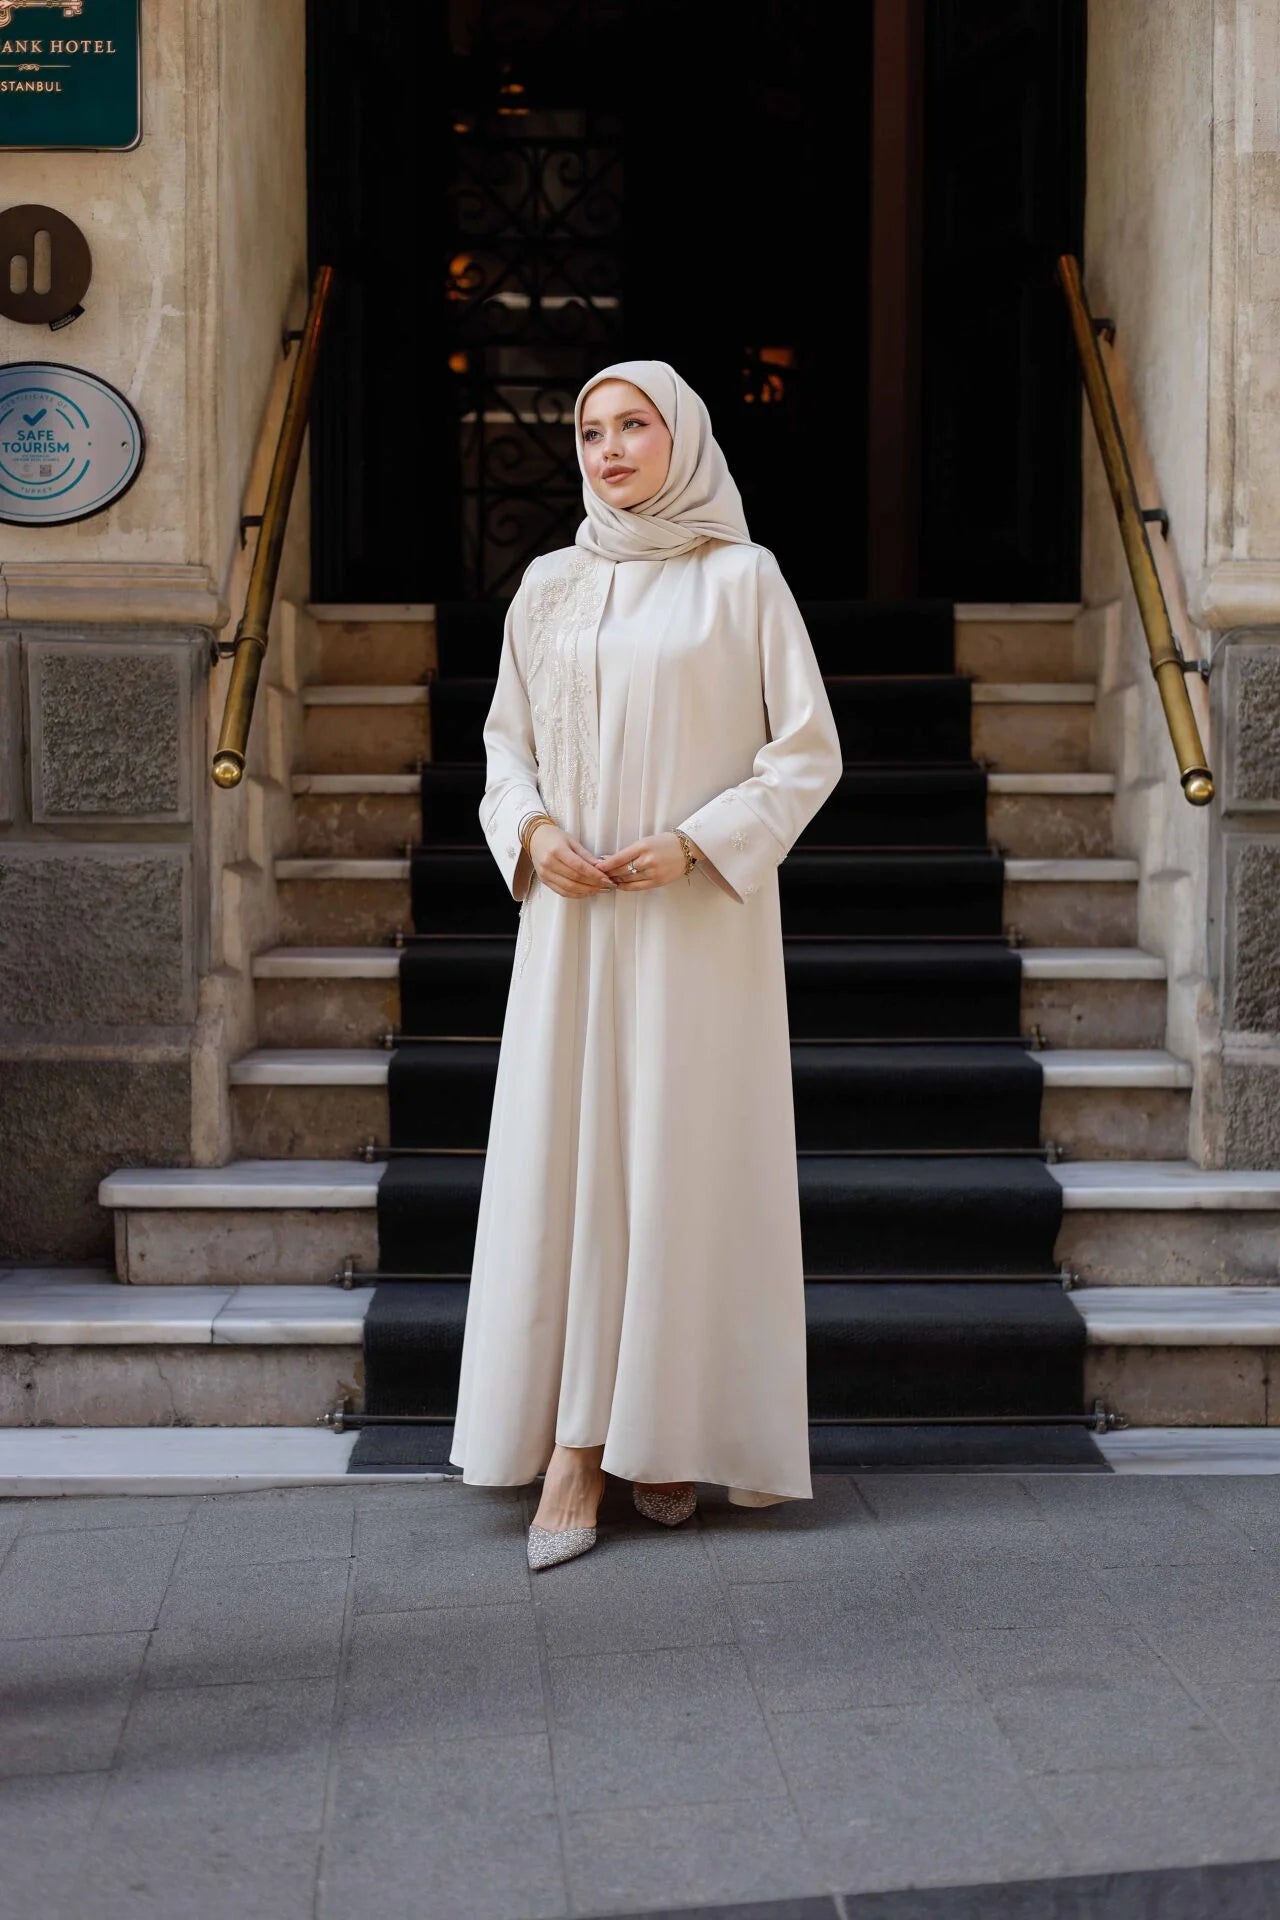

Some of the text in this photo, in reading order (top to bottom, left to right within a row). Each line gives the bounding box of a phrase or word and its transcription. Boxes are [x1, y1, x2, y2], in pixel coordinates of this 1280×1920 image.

[50, 40, 116, 54] HOTEL
[0, 81, 62, 92] STANBUL
[17, 430, 54, 441] SAFE
[2, 442, 70, 453] TOURISM
